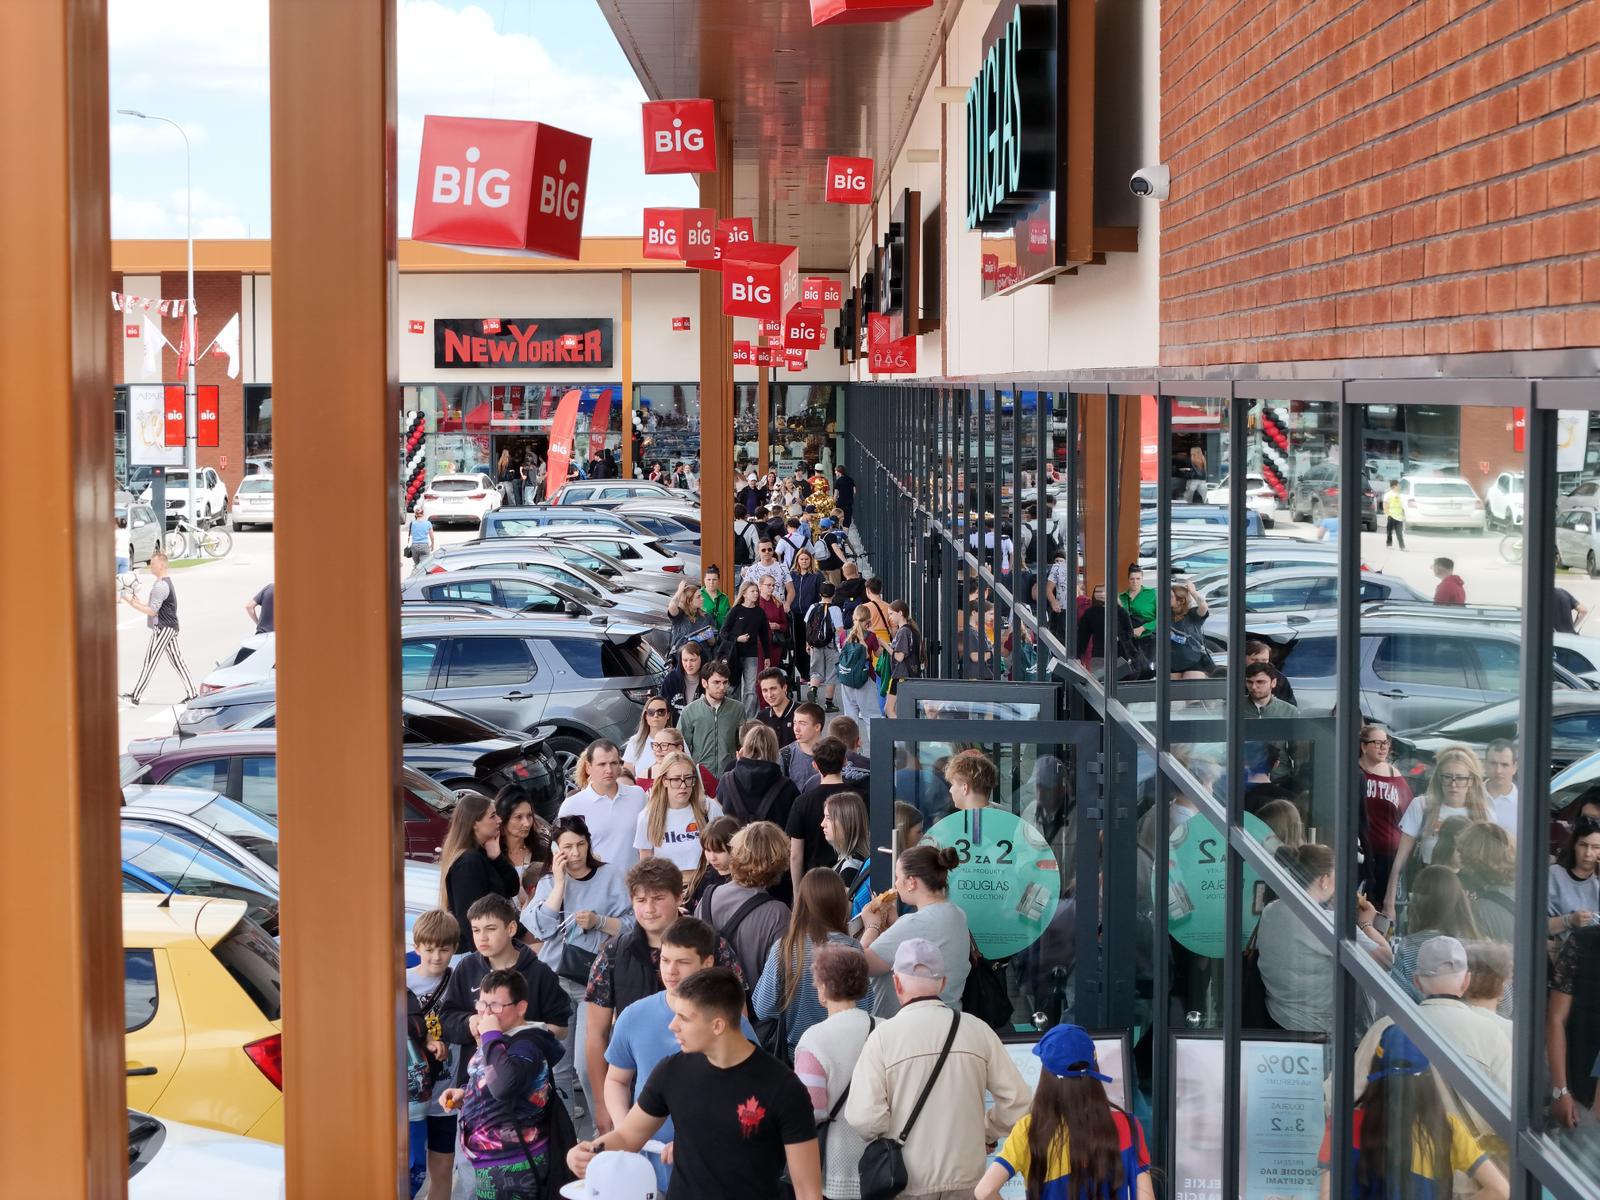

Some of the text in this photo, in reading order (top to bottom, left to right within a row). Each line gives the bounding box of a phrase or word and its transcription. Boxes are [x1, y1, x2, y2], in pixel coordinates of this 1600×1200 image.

[955, 839, 1013, 864] 3 ZA 2
[957, 879, 1010, 892] DOUGLAS
